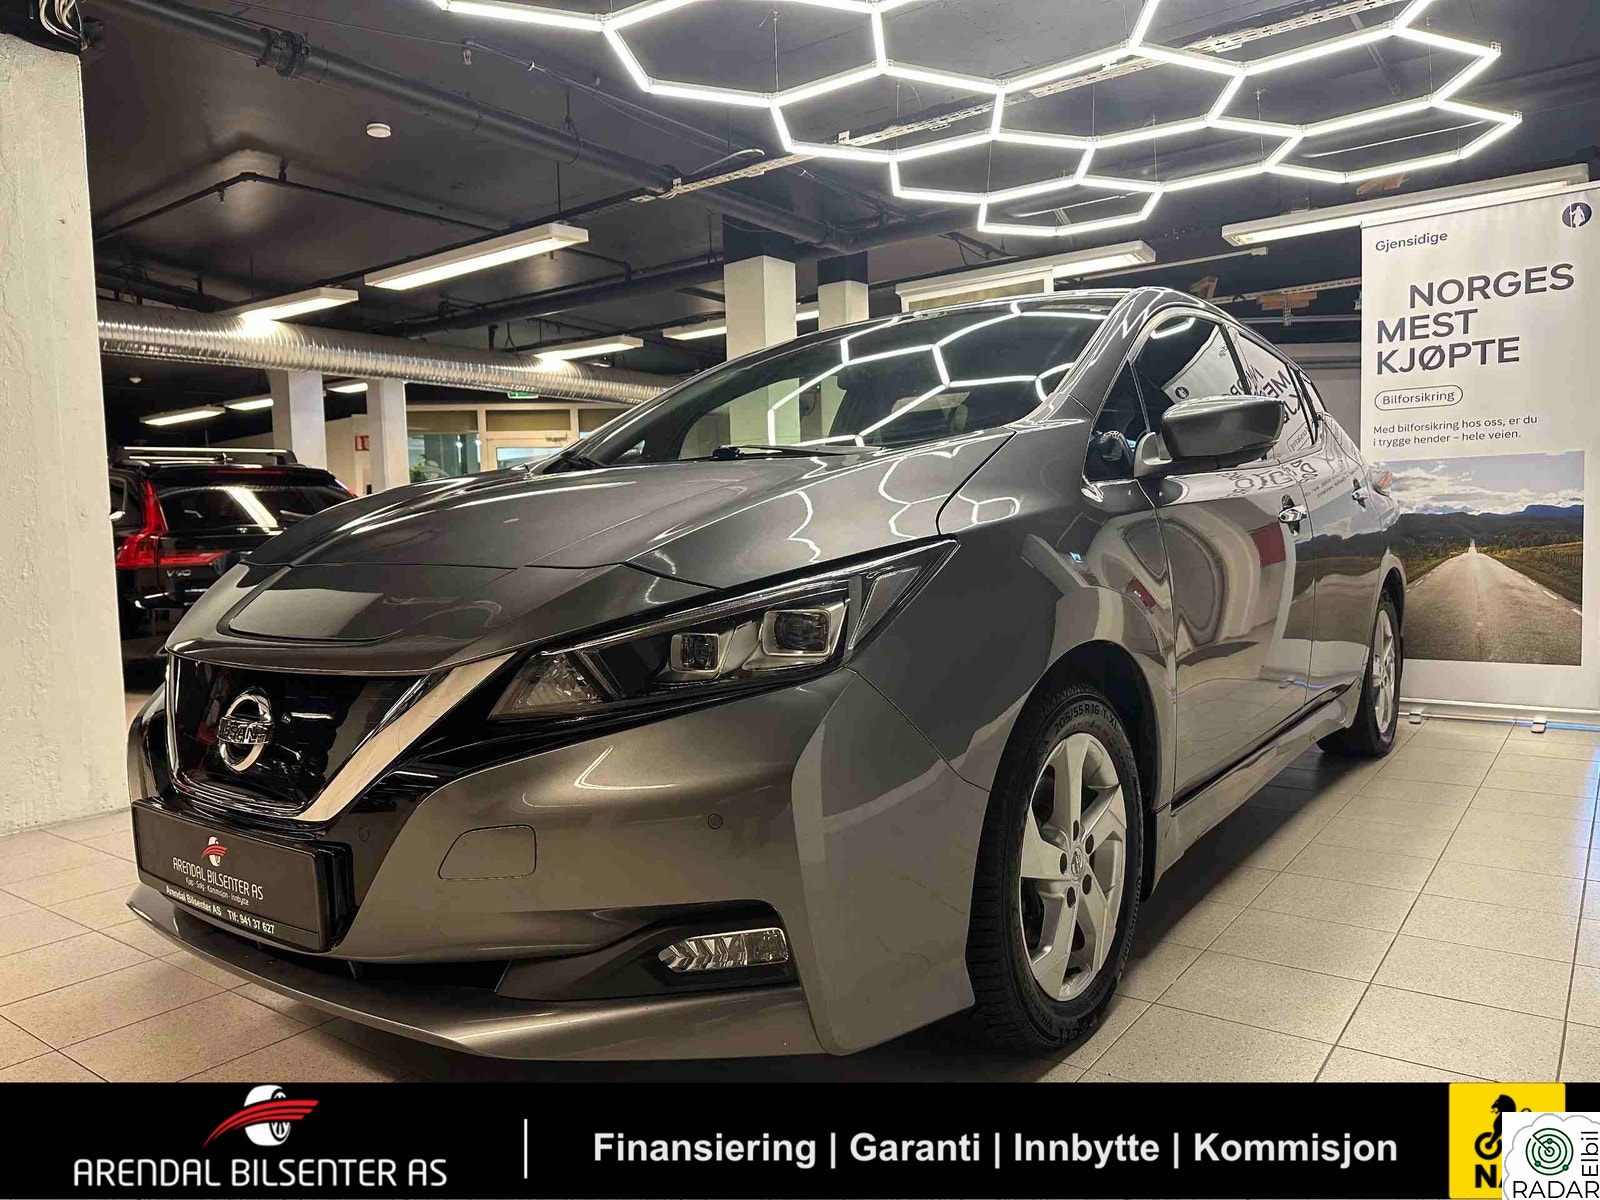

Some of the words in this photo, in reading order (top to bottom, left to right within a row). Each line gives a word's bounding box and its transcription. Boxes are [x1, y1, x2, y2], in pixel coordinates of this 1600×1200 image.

[1375, 231, 1448, 252] Gjensidige
[1409, 263, 1575, 309] NORGES
[1377, 308, 1478, 344] MEST
[1376, 336, 1520, 375] KJØPTE
[1382, 390, 1455, 405] Bilforsikring
[1373, 425, 1395, 434] Med
[1397, 420, 1460, 433] bilforsikring
[1462, 419, 1482, 428] hos
[1484, 417, 1506, 428] oss,
[1509, 417, 1520, 425] er
[1523, 415, 1538, 424] du
[1379, 437, 1411, 448] trygge
[1414, 434, 1450, 444] hender
[1462, 431, 1485, 441] hele
[1488, 430, 1521, 440] veien.
[1054, 705, 1084, 735] 205/55
[1084, 703, 1090, 714] R
[1091, 705, 1100, 715] 16
[1108, 717, 1118, 732] XL
[172, 857, 206, 882] ARENDAL
[207, 869, 250, 897] BILSENTER
[251, 884, 264, 900] AS
[166, 885, 186, 900] Arendal
[186, 894, 212, 912] Bilsenter
[212, 904, 222, 916] AS
[240, 914, 250, 926] 941
[252, 918, 261, 930] 37
[262, 922, 274, 934] 627
